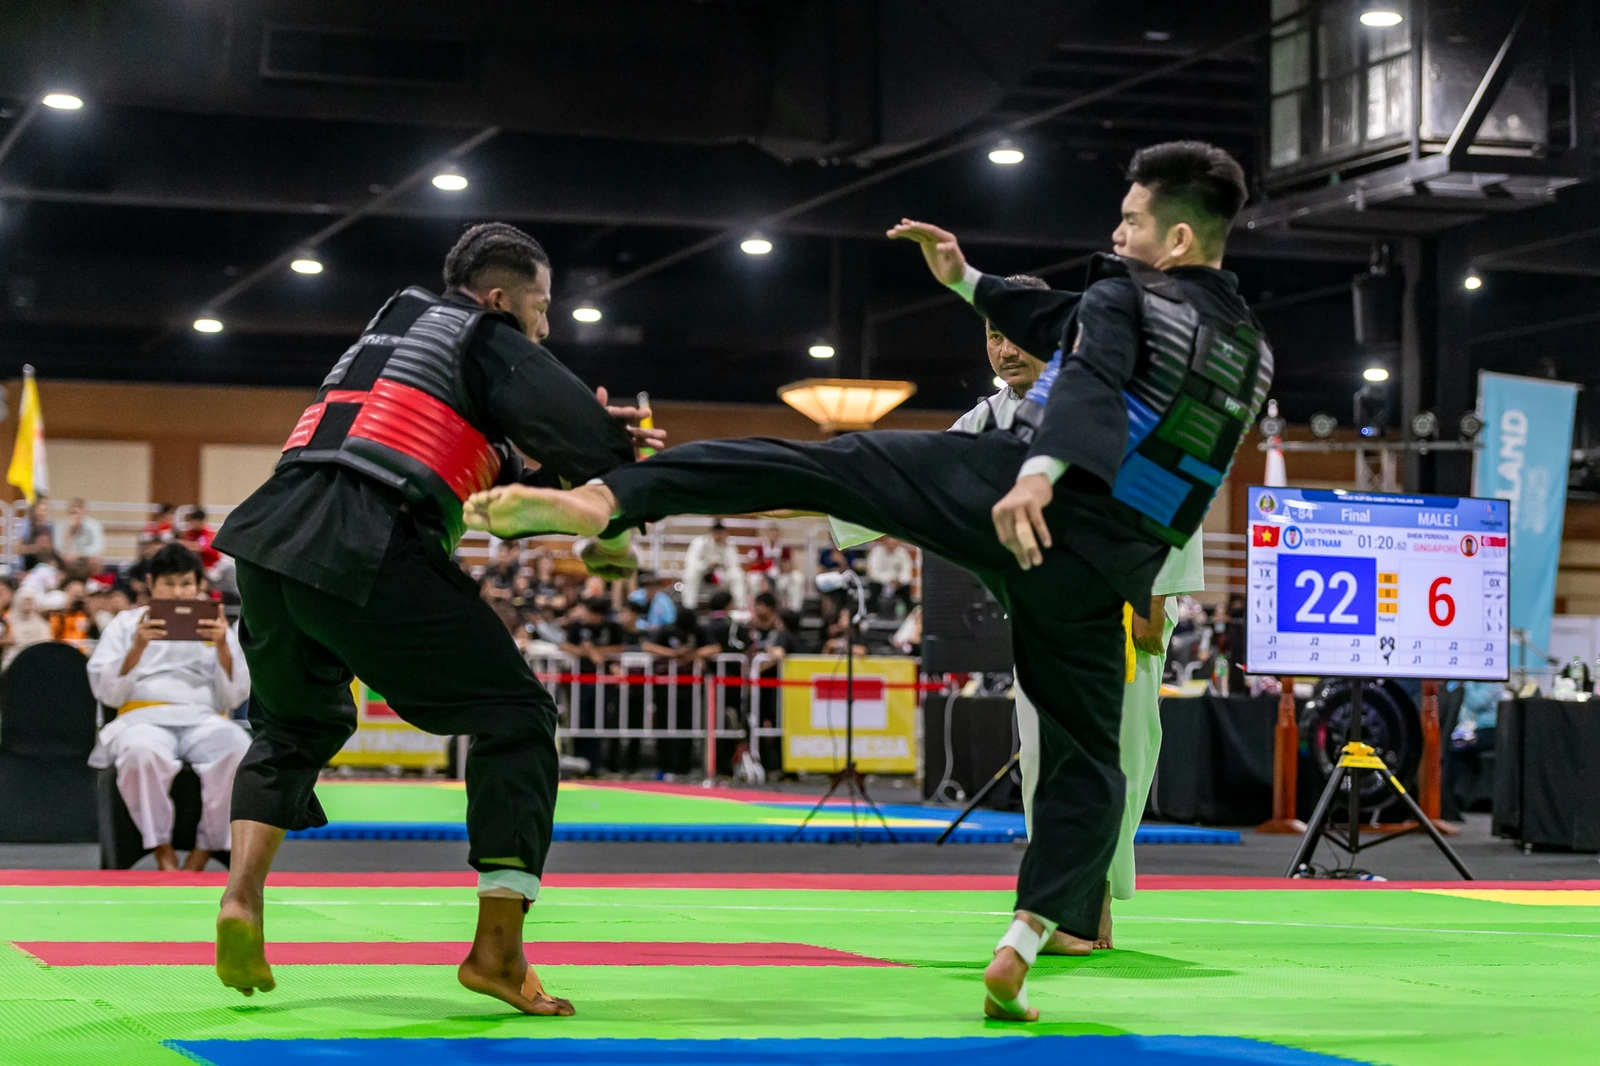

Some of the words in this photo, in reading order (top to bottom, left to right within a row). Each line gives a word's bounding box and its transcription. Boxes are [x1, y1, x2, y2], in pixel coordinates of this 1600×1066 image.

[1341, 508, 1371, 522] Final
[1418, 512, 1452, 527] MALE
[1303, 538, 1342, 548] VIETNAM
[1413, 543, 1458, 554] SINGAPORE
[1260, 568, 1271, 578] 1X
[1295, 569, 1359, 625] 22
[1428, 576, 1456, 627] 6
[1267, 636, 1277, 645] J1
[1310, 637, 1319, 646] J2
[1350, 638, 1360, 647] J3
[1413, 640, 1421, 650] J1
[1449, 641, 1458, 651] J2
[1484, 643, 1494, 652] J3
[1267, 651, 1277, 660] J1
[1310, 652, 1319, 661] J2
[1350, 653, 1360, 662] J3
[1412, 655, 1421, 664] J1
[1449, 656, 1458, 665] J2
[1484, 658, 1494, 667] J3
[790, 736, 909, 759] INDONESIA
